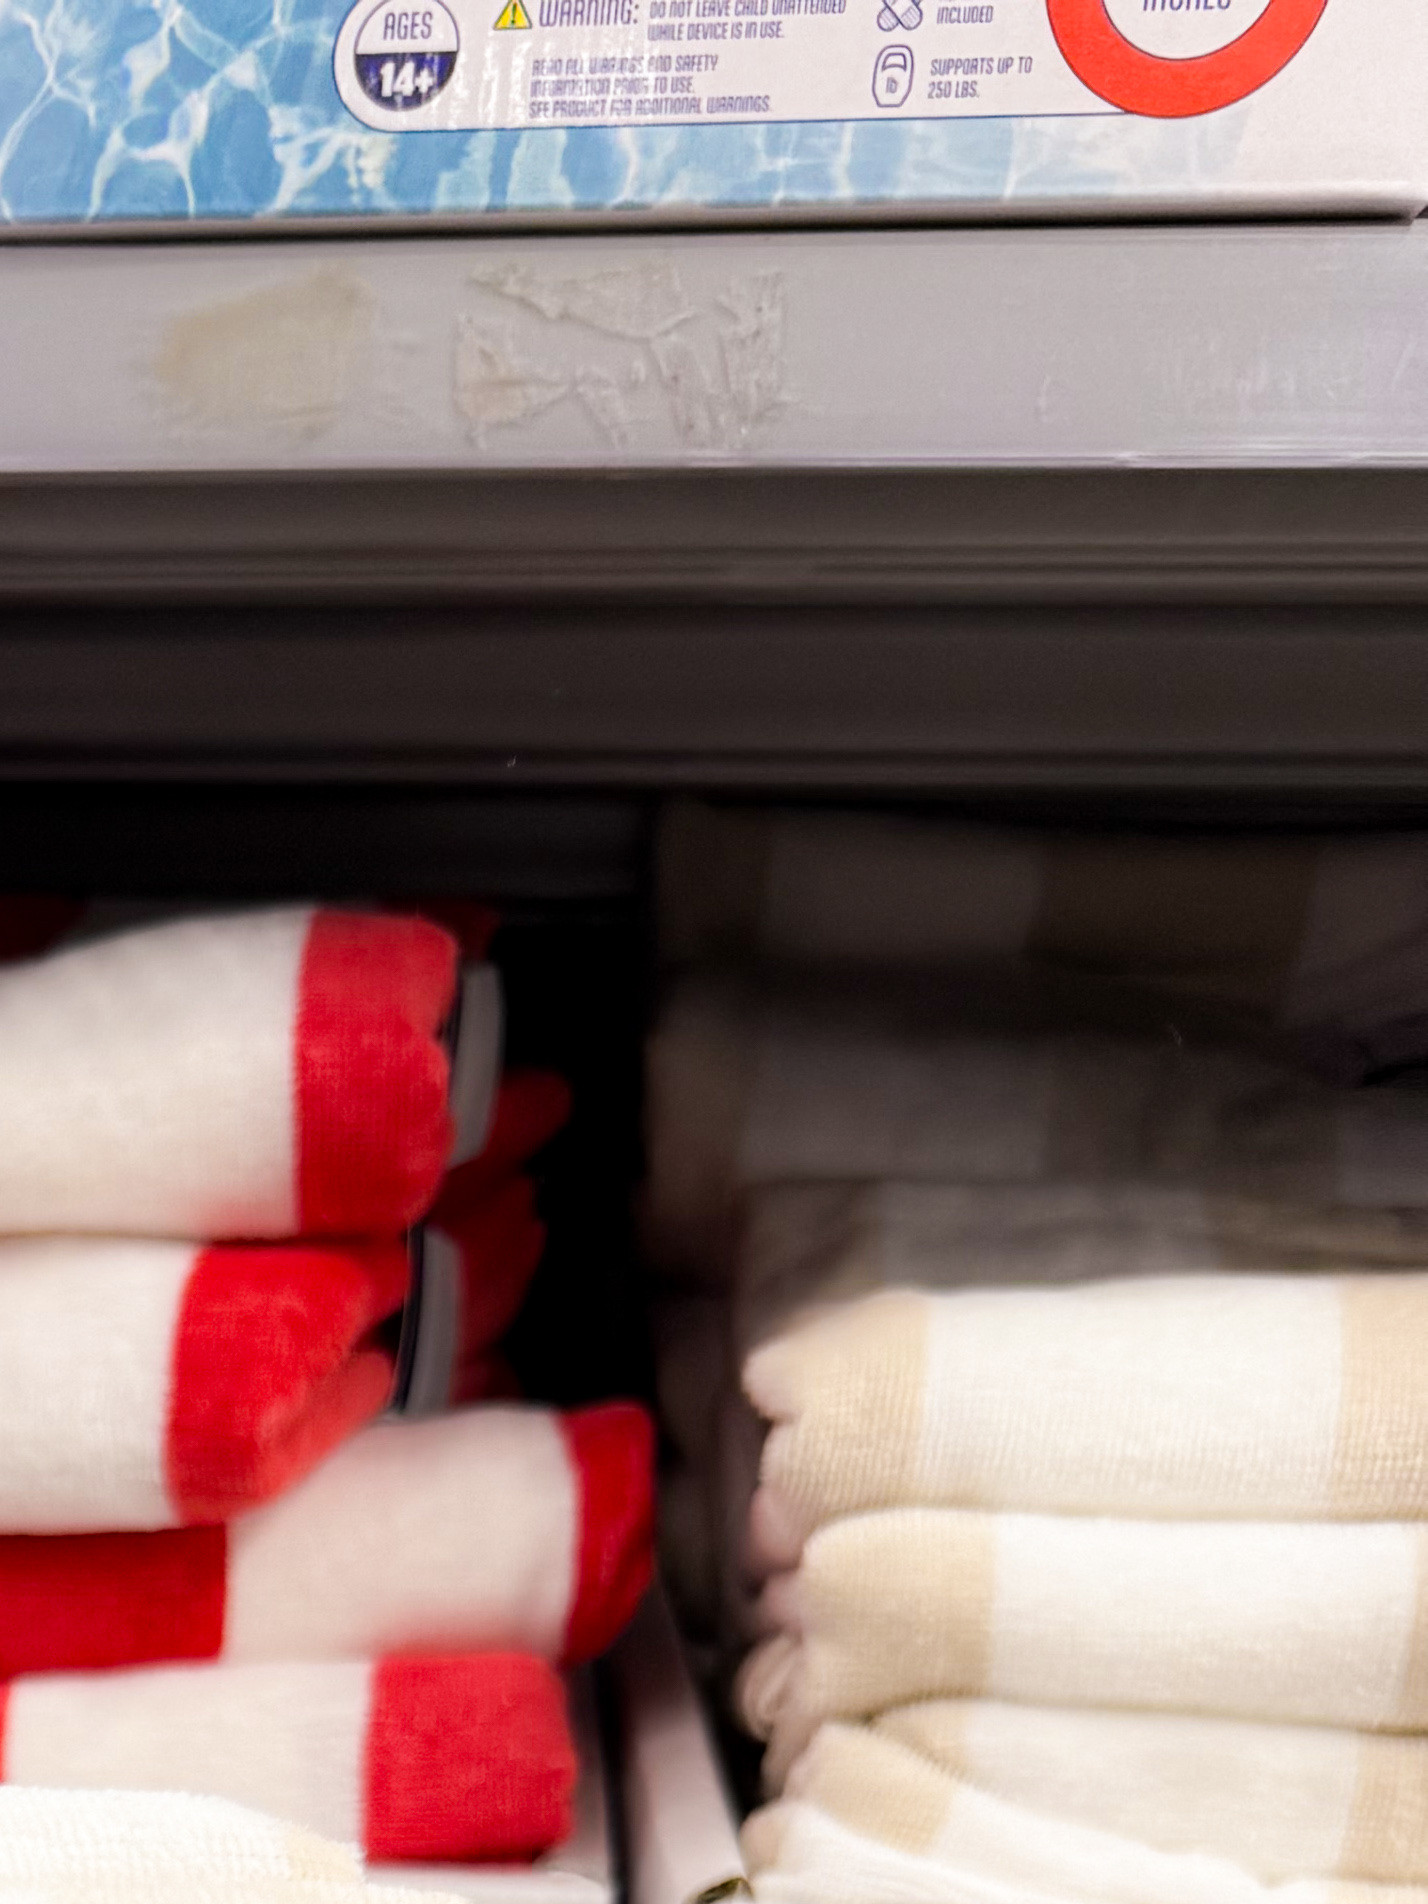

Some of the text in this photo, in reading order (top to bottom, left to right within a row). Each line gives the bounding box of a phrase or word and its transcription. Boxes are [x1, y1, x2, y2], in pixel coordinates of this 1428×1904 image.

[538, 0, 639, 28] WARNING:
[695, 0, 732, 17] LEAVE
[734, 0, 767, 16] CHILD
[937, 4, 993, 25] INCLUDED
[383, 12, 433, 40] AGES
[647, 23, 683, 41] WHILE
[687, 22, 728, 40] DEVICE
[730, 22, 743, 39] IS
[745, 21, 757, 38] IN
[675, 54, 718, 72] SAFETY
[931, 56, 1033, 76] SUPPORTS UP TO
[380, 61, 434, 97] 14+
[928, 82, 951, 99] 250
